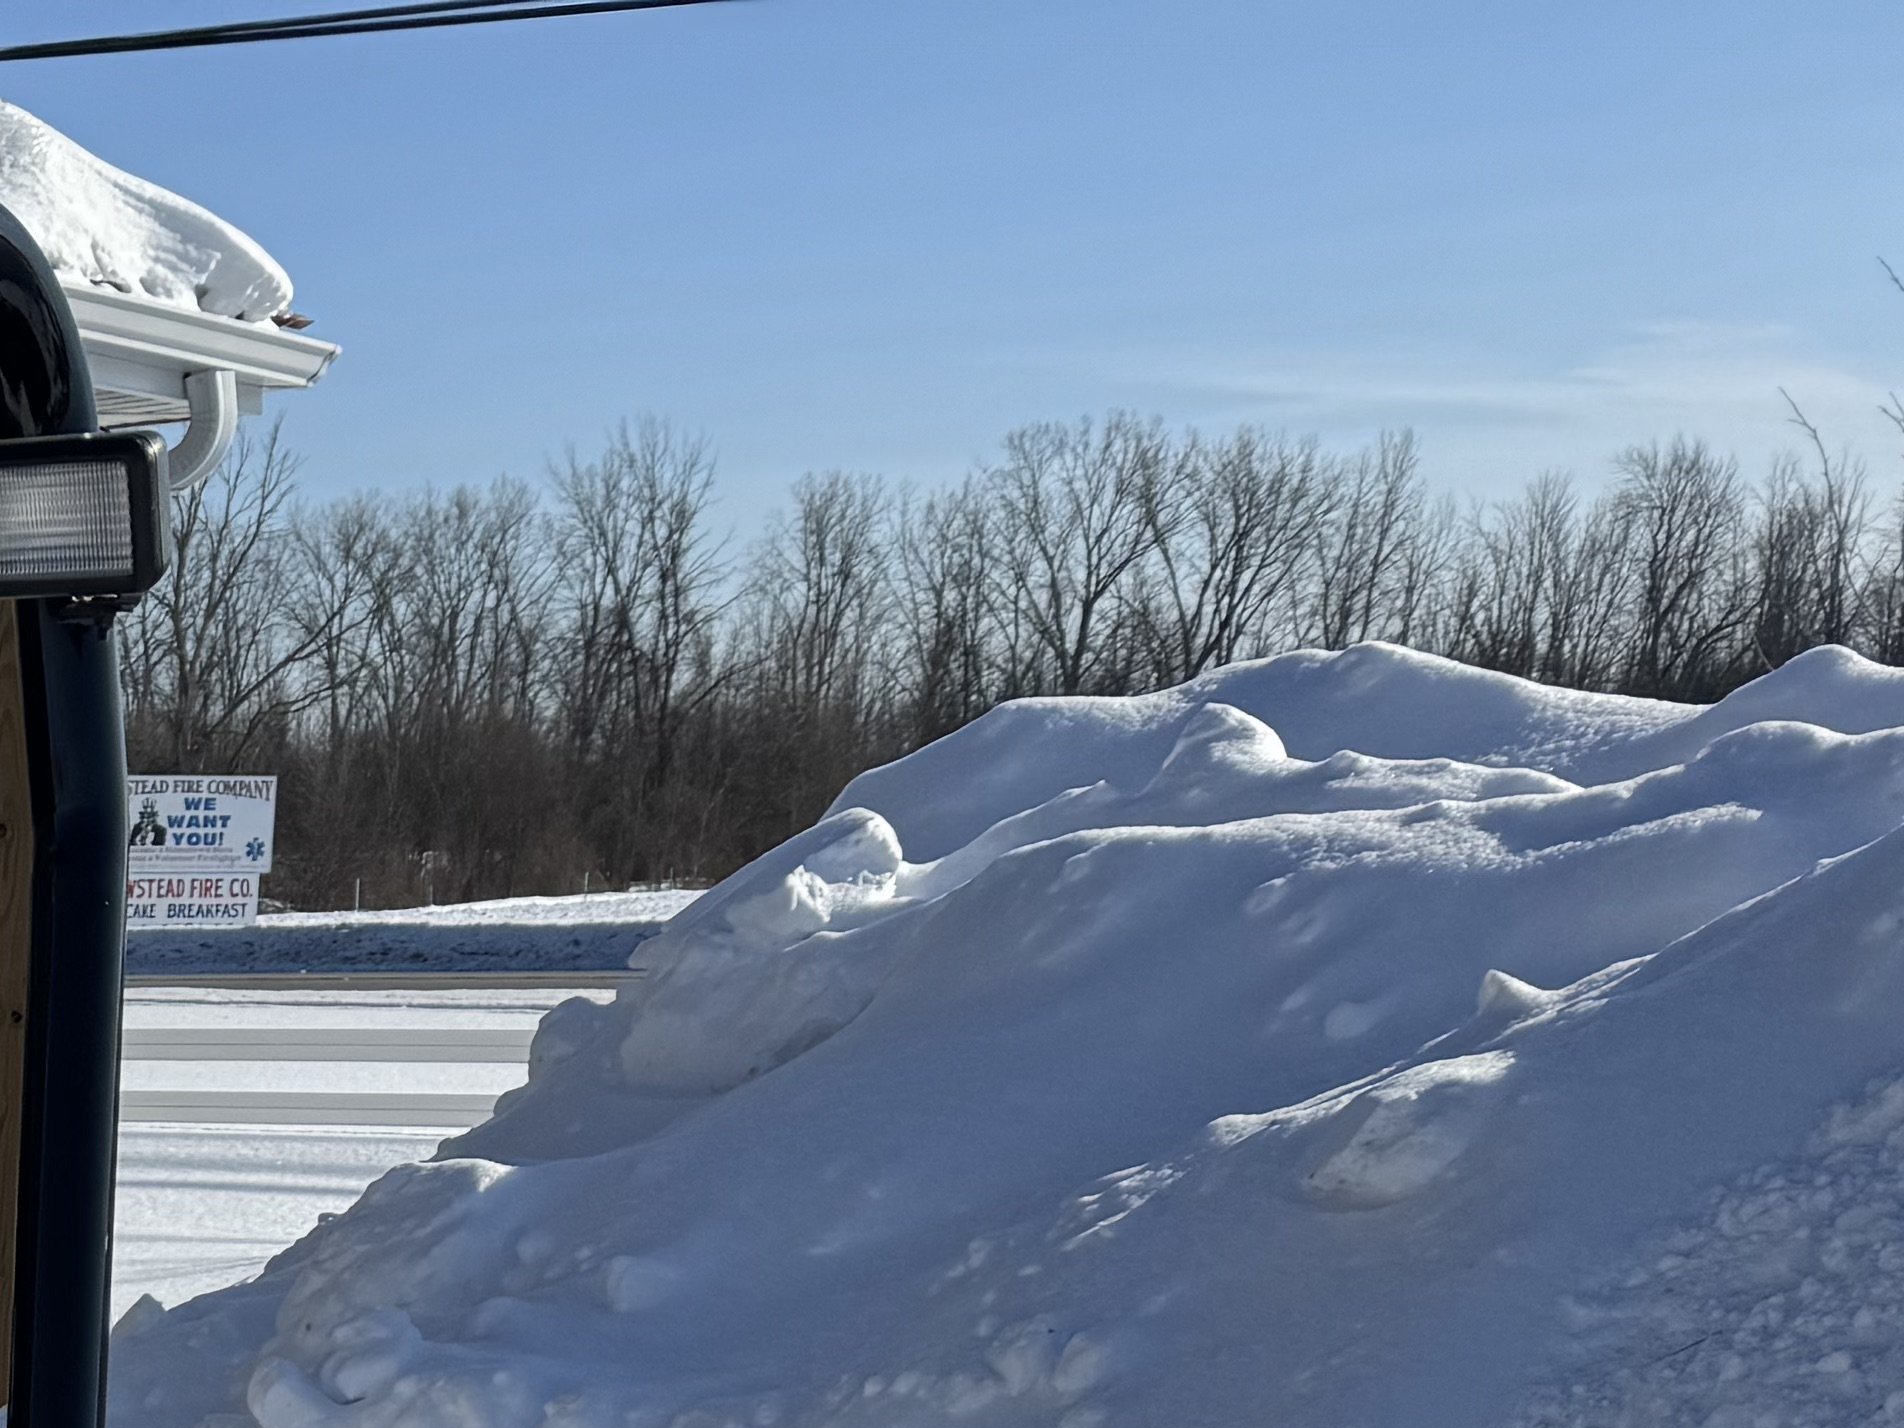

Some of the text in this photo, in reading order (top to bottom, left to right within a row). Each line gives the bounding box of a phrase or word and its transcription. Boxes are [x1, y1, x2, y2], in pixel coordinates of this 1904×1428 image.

[173, 780, 204, 794] FIRE
[207, 779, 274, 801] COMPANY
[184, 797, 217, 811] WE
[167, 815, 231, 828] WANT
[172, 832, 224, 846] YOU!
[190, 879, 224, 898] FIRE
[230, 878, 253, 898] CO.
[167, 903, 248, 919] BREAKFAST
